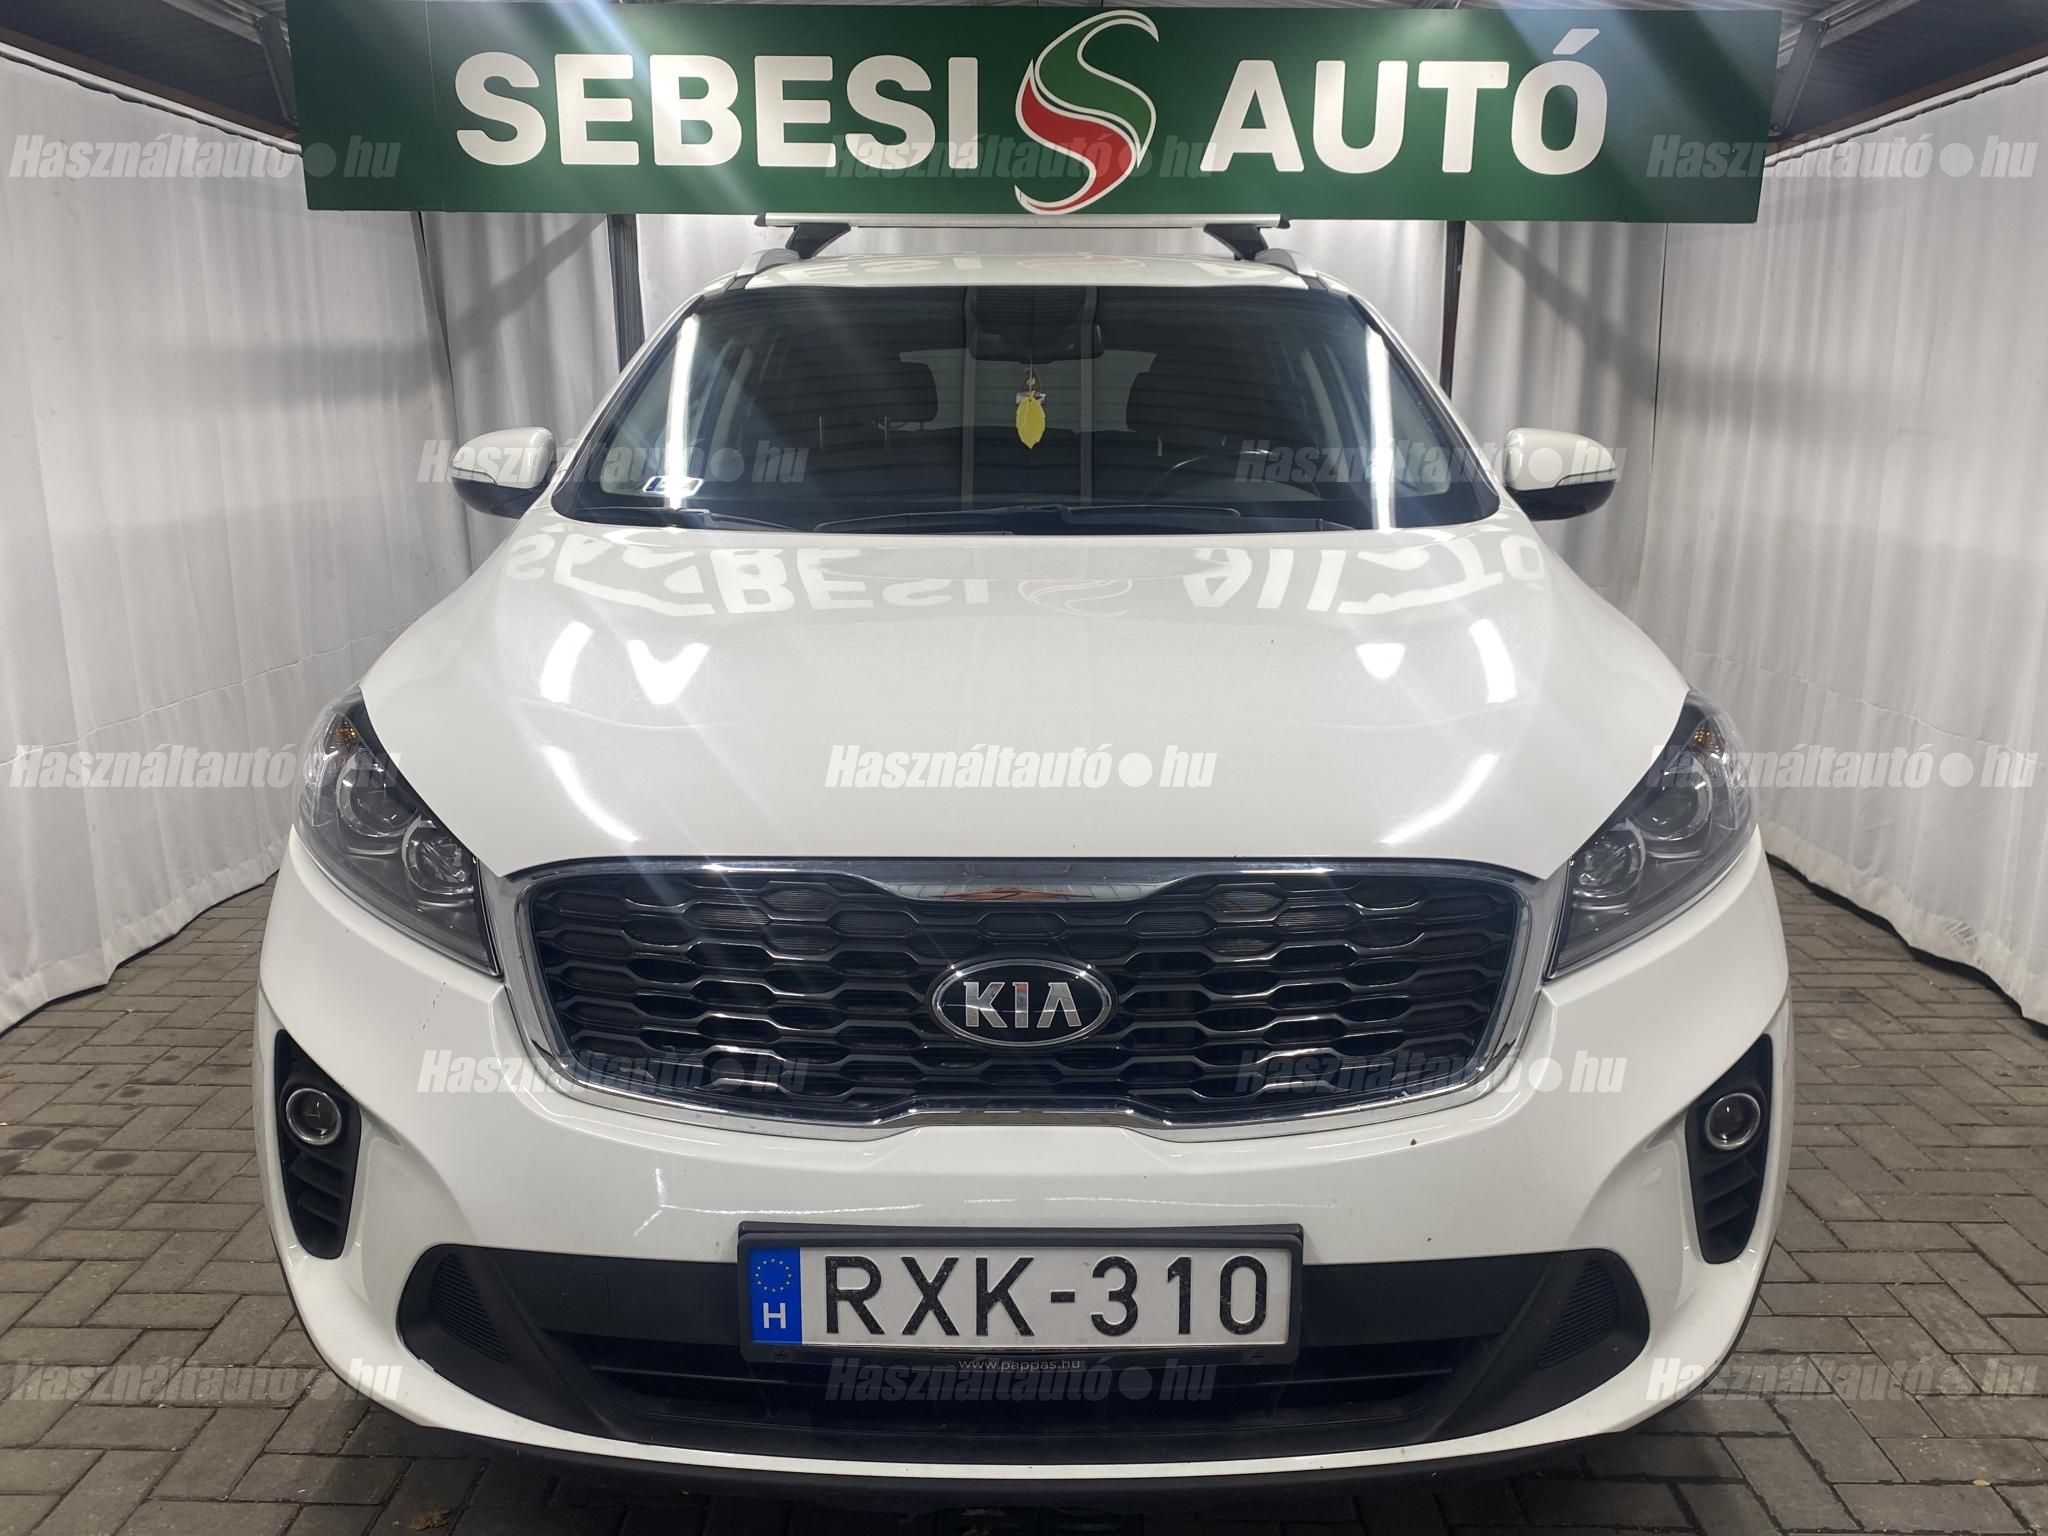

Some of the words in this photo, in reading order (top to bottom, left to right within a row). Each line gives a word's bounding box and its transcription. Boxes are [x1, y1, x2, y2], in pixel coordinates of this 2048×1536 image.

[455, 51, 979, 168] SEBESI
[1200, 28, 1608, 175] AUTÓ
[963, 981, 1083, 1030] KIA
[762, 1302, 787, 1330] H
[824, 1254, 1268, 1337] RXK-310
[958, 1359, 1081, 1372] www.pappas.hu
